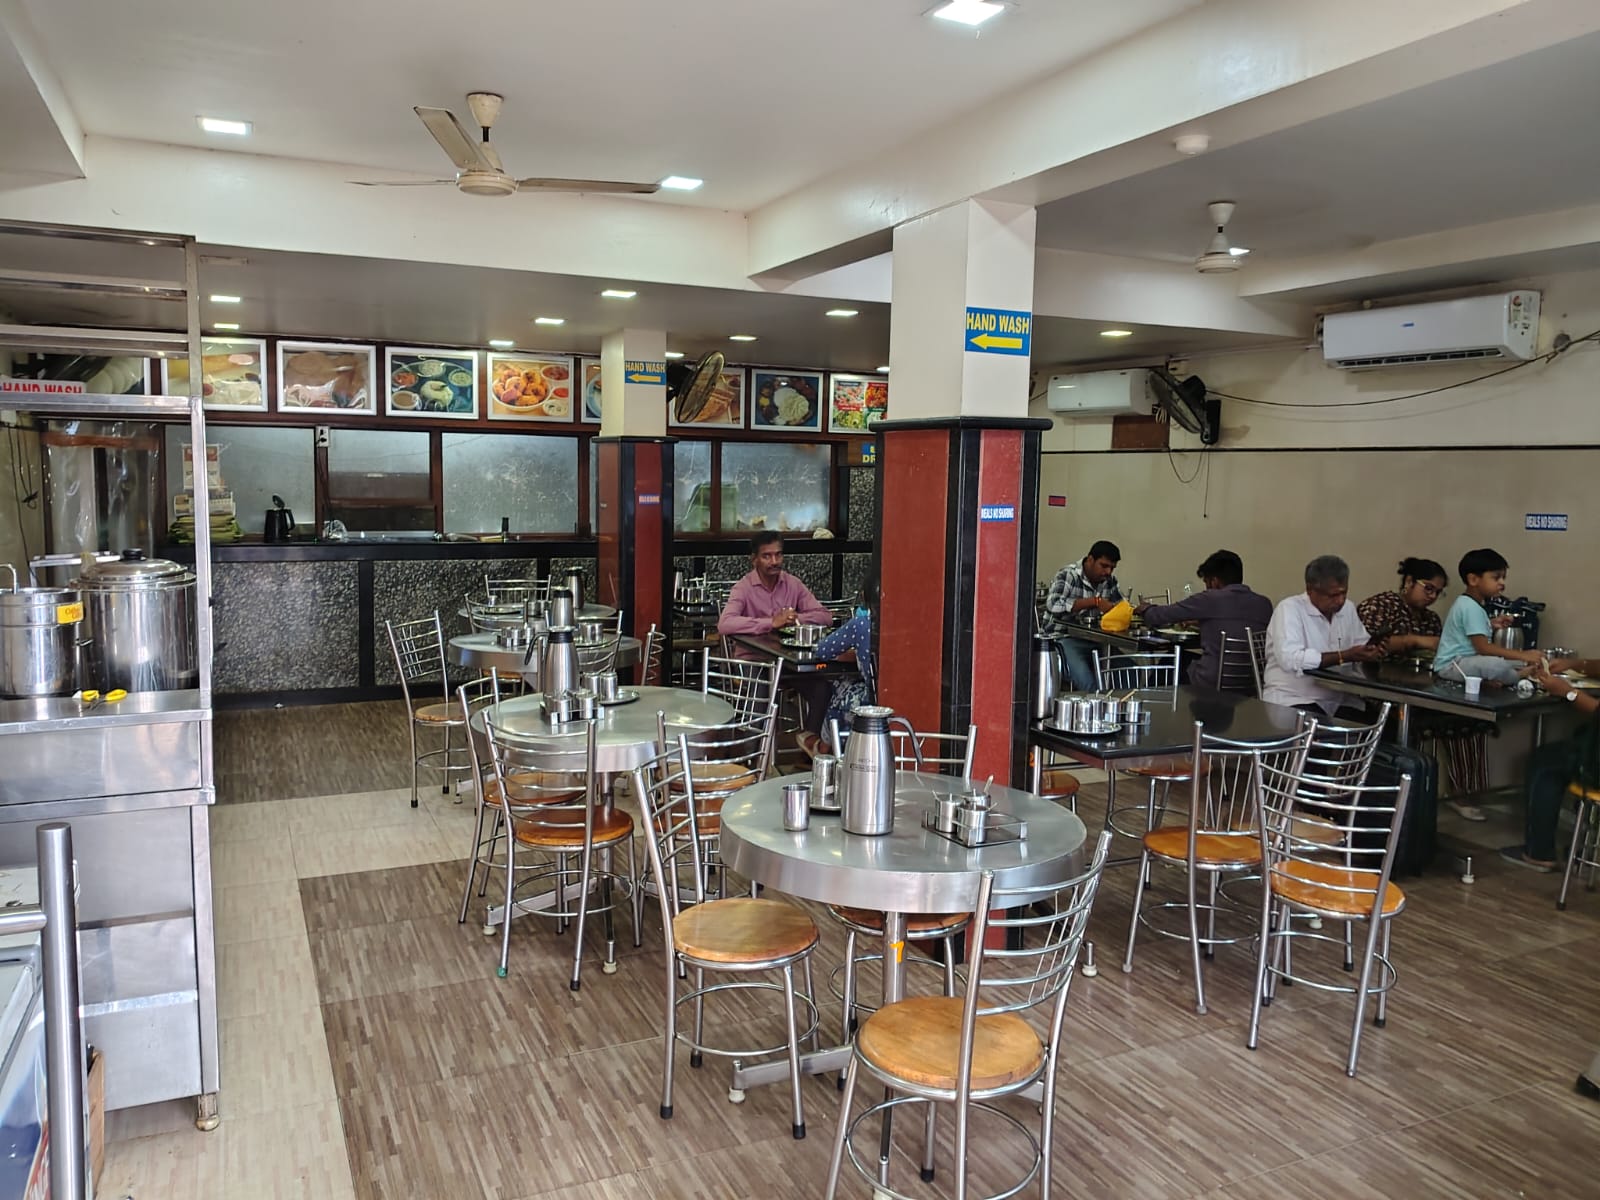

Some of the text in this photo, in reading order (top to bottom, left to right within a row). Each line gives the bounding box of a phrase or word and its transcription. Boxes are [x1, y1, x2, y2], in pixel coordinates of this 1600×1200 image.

[966, 312, 1030, 334] HAND WASH
[624, 362, 665, 373] HAND WASH
[3, 382, 82, 393] HAND WASH
